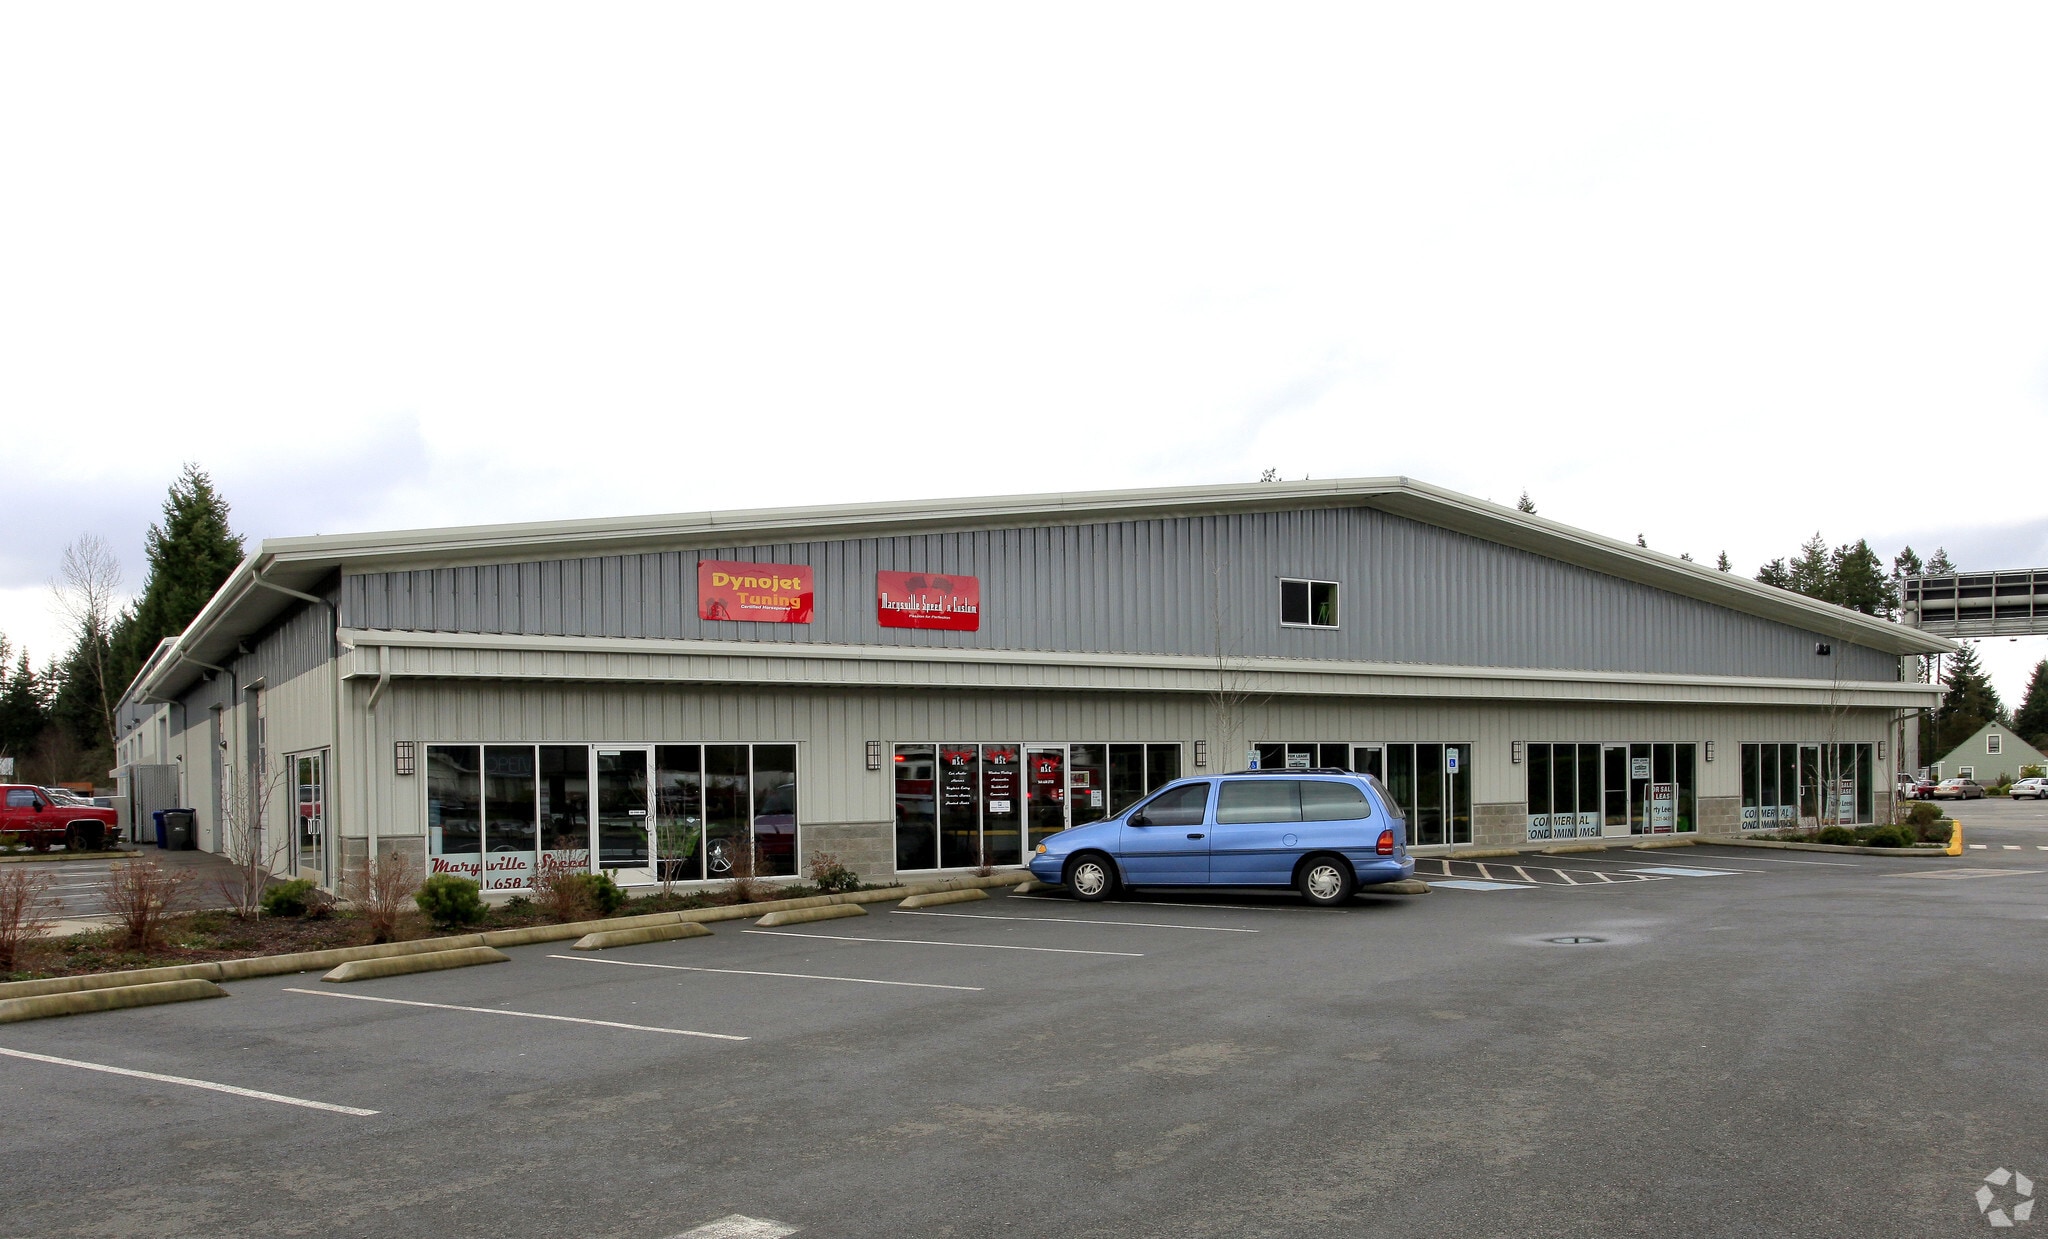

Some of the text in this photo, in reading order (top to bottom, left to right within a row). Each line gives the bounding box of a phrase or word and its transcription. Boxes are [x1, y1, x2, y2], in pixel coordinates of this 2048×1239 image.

[712, 572, 801, 592] Dynojet
[736, 592, 801, 609] Tuning
[881, 592, 920, 612] Marysville
[922, 594, 943, 613] Speed
[953, 596, 977, 614] Custom
